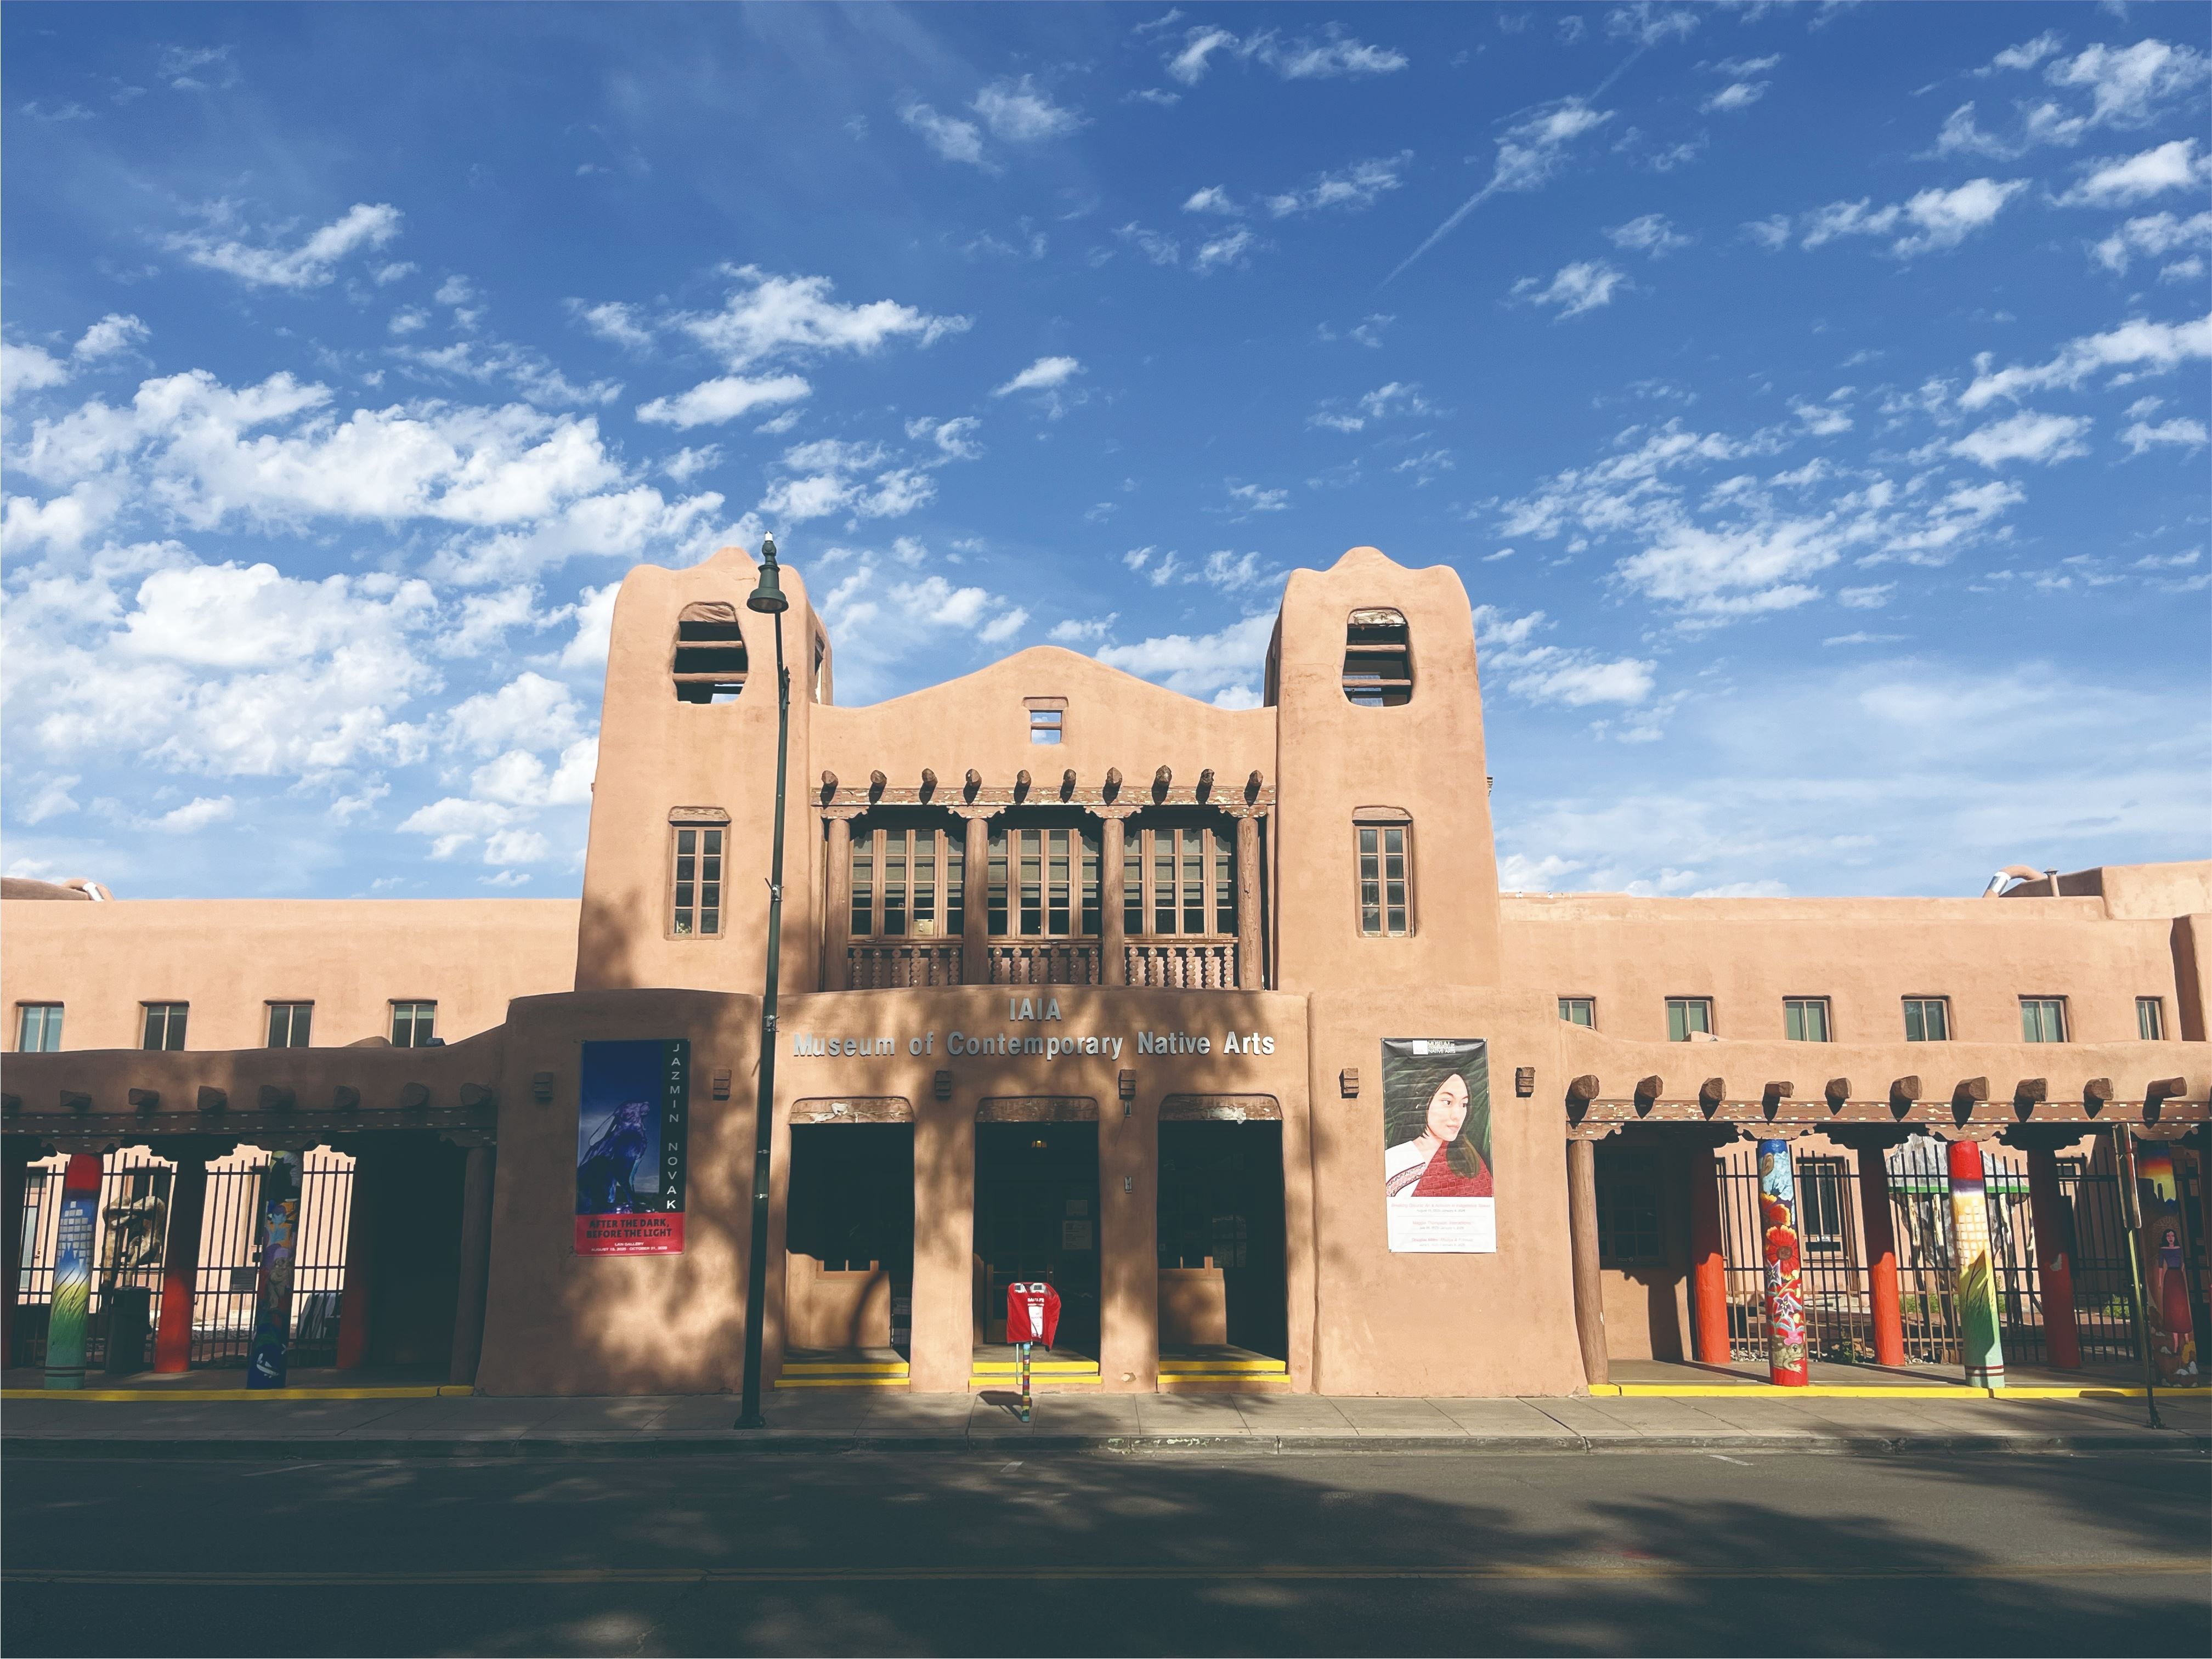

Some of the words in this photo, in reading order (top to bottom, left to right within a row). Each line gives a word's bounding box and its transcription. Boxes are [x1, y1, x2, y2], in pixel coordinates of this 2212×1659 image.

[1009, 998, 1062, 1022] IAIA
[793, 1033, 895, 1057] Museum
[909, 1031, 934, 1055] of
[947, 1031, 1123, 1060] Contemporary
[1138, 1030, 1210, 1055] Native
[1223, 1031, 1275, 1055] Arts
[669, 1044, 681, 1123] JAZMIN
[666, 1142, 678, 1209] NOVAK
[586, 1230, 621, 1238] BEFORE
[624, 1229, 642, 1237] THE
[643, 1228, 672, 1237] LIGHT
[589, 1219, 618, 1228] AFTER
[620, 1219, 637, 1227] THE
[640, 1219, 670, 1227] DARK,
